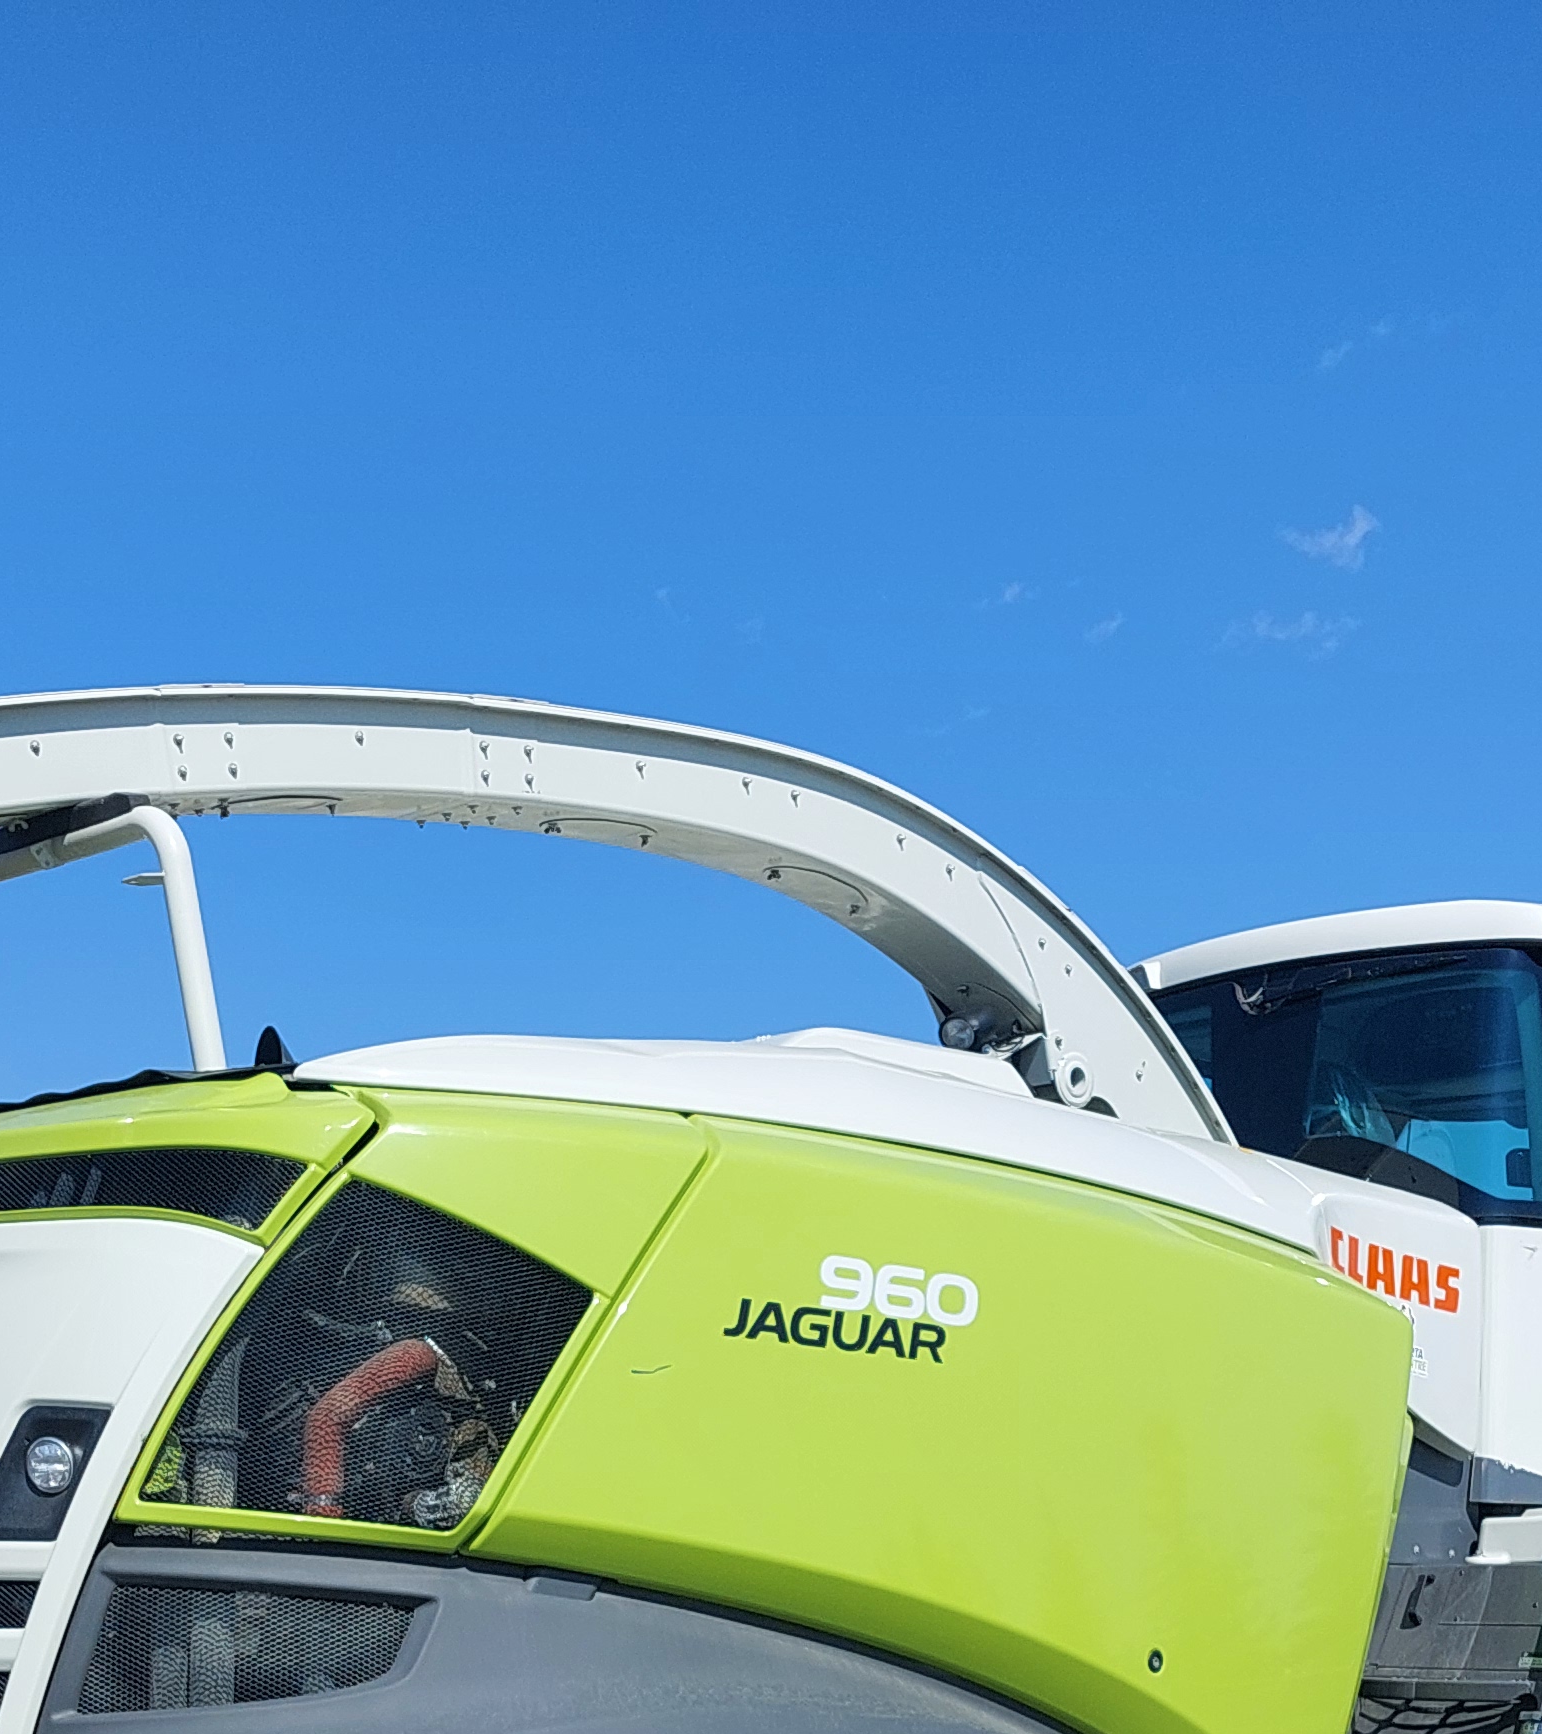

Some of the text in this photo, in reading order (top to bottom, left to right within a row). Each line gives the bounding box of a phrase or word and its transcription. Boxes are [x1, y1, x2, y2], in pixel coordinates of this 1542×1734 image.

[820, 1255, 979, 1326] 960
[1331, 1226, 1460, 1313] CLAAS
[723, 1298, 946, 1364] JAGUAR
